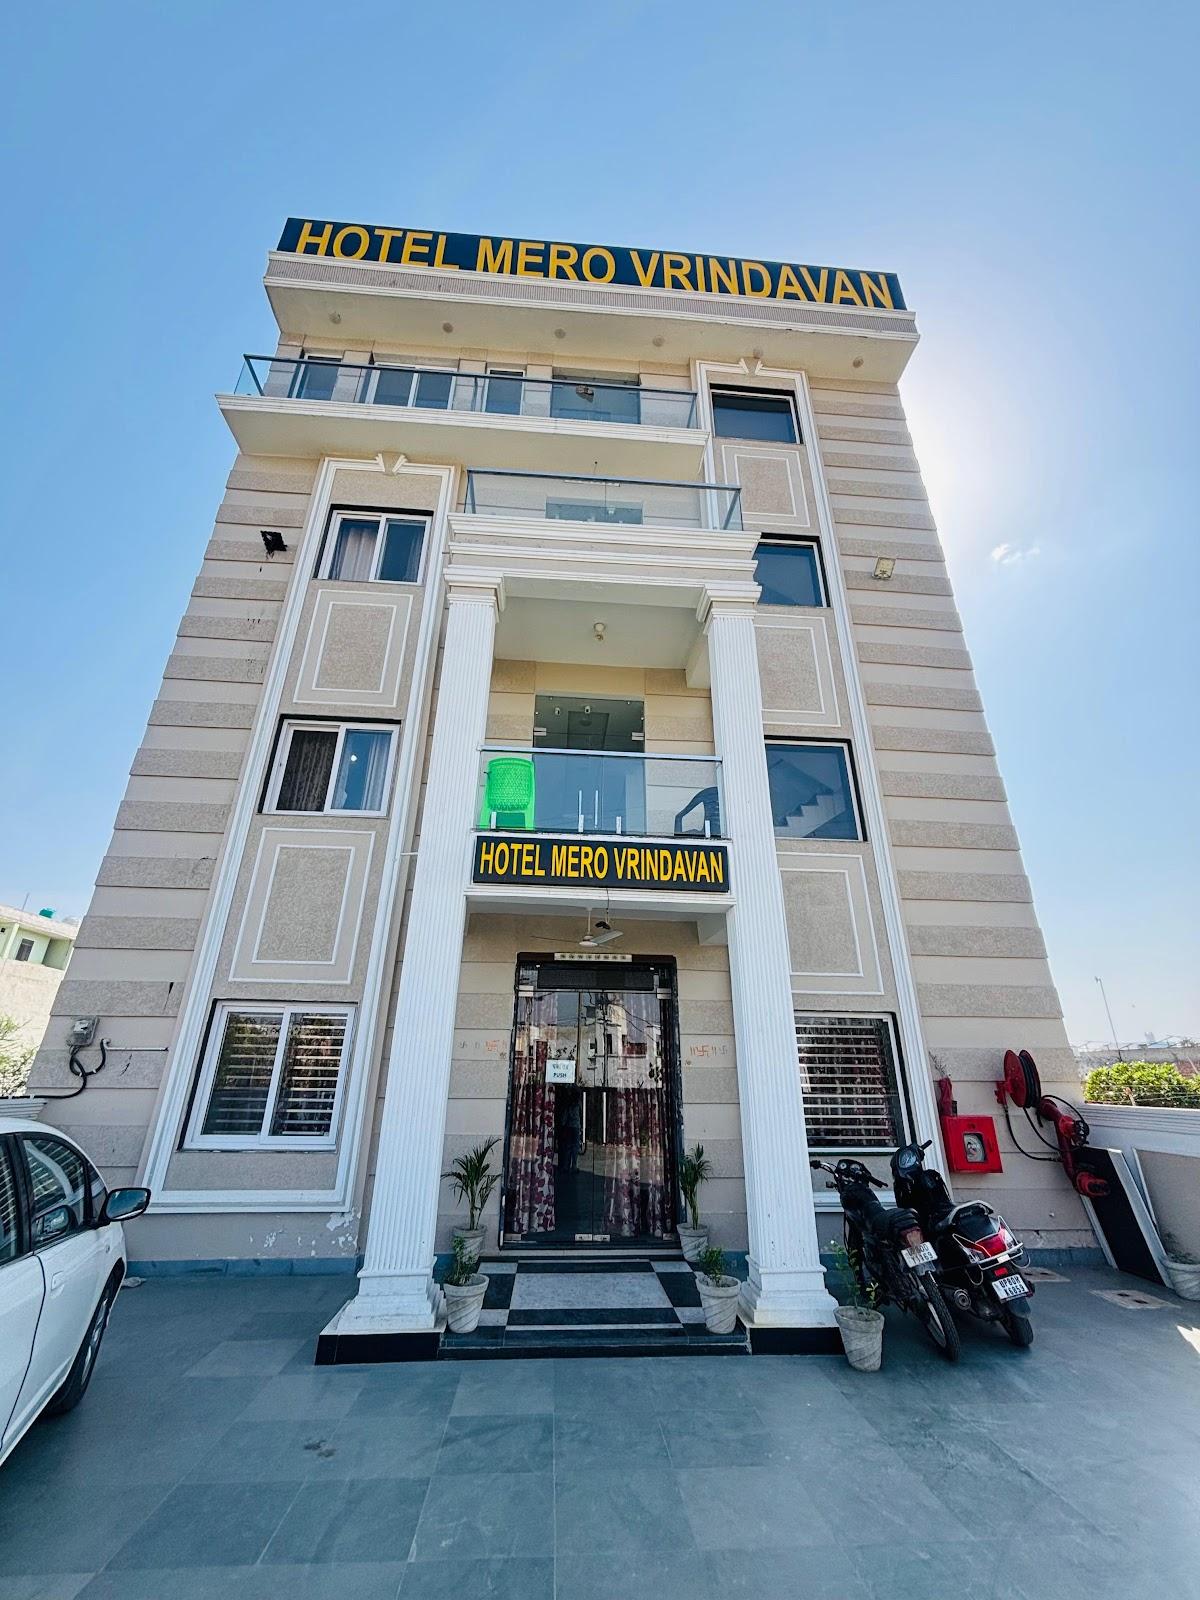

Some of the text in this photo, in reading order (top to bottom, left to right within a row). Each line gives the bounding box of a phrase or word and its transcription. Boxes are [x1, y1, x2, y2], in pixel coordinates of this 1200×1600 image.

[296, 222, 893, 309] HOTEL MERO VRINDAVAN
[479, 841, 724, 883] HOTEL MERO VRINDAVAN
